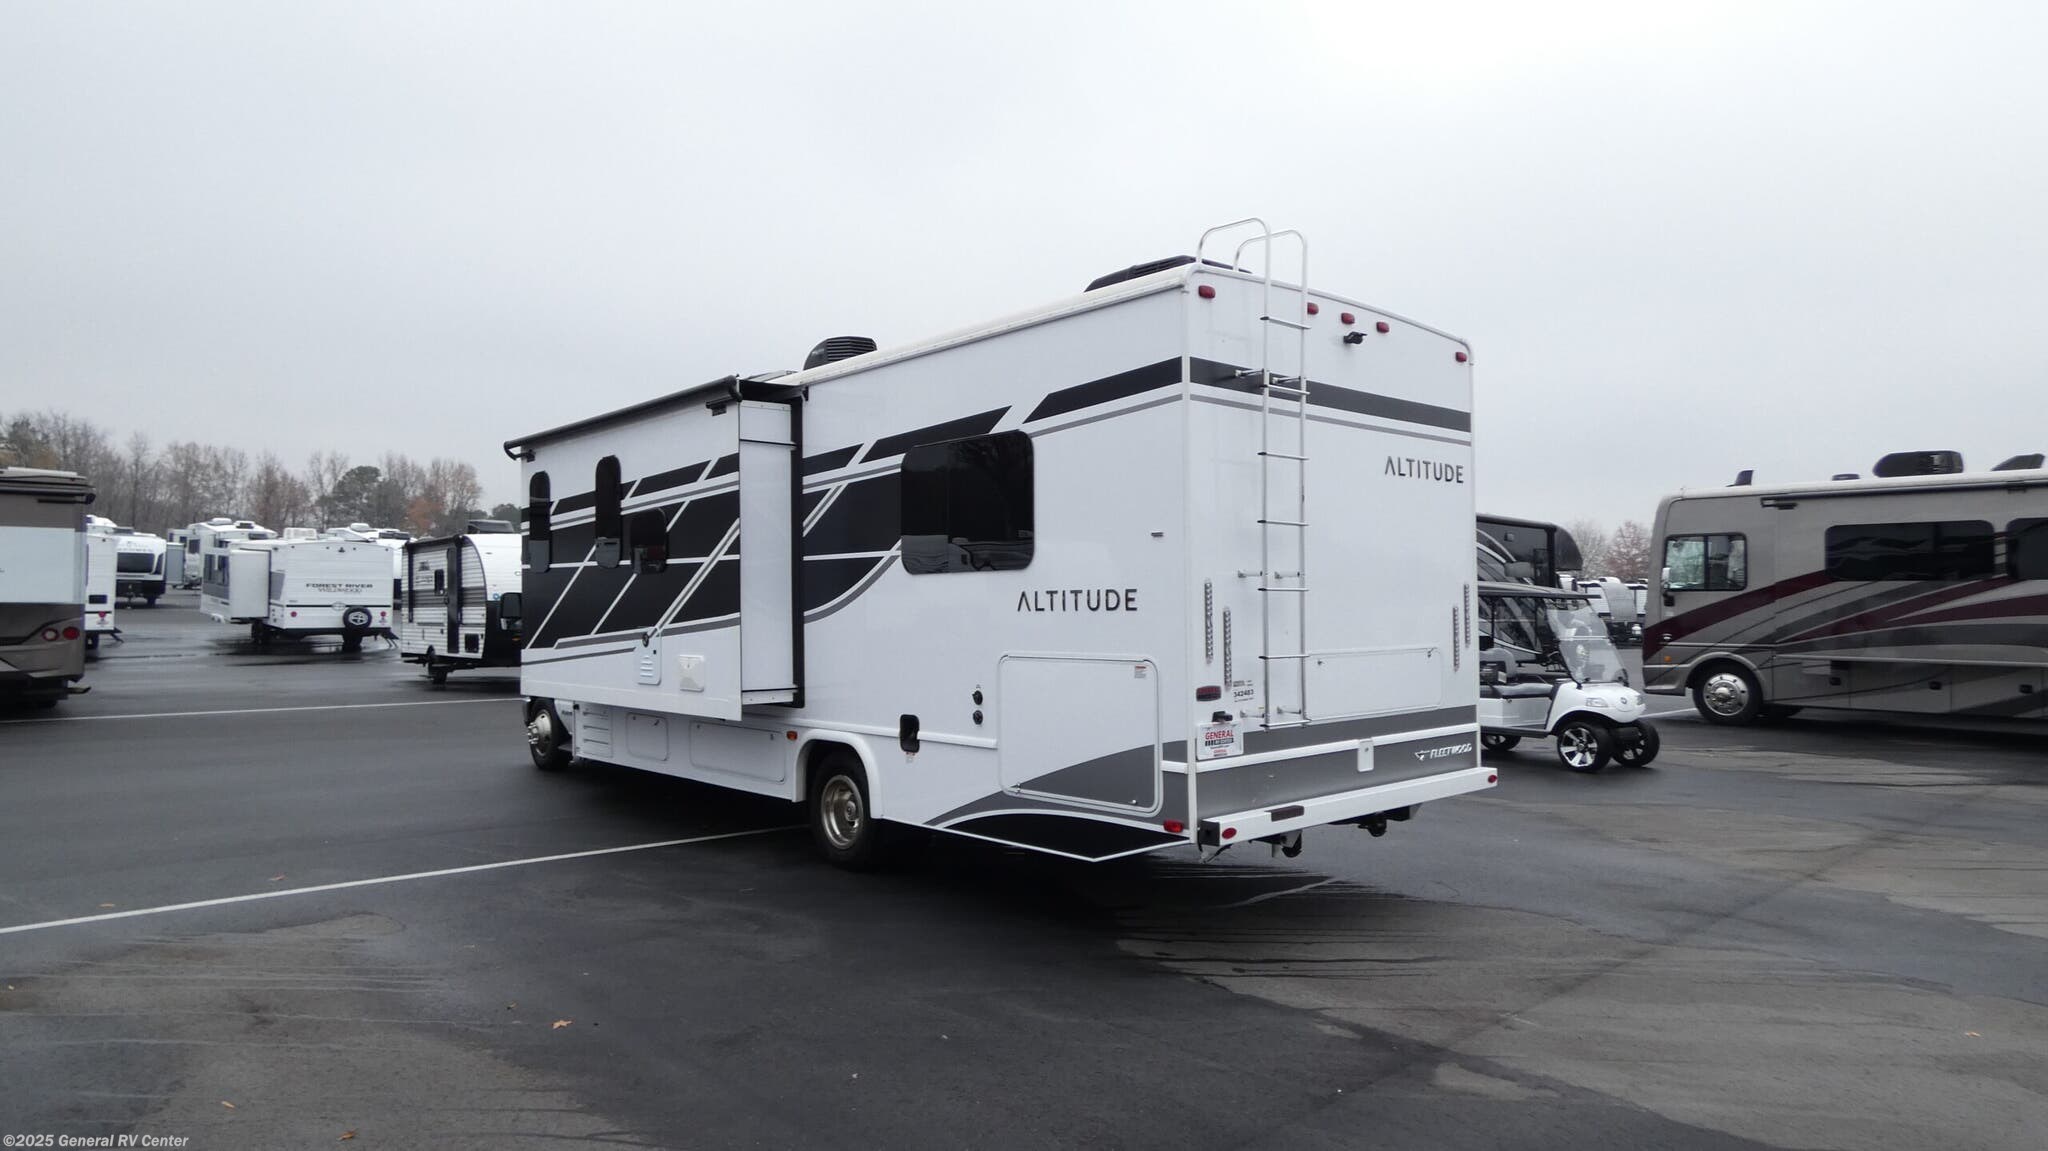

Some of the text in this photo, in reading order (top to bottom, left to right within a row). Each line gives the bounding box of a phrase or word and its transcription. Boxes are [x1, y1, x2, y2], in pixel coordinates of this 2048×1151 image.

[1385, 455, 1464, 484] ALTITUDE
[1017, 588, 1138, 612] ALTITUDE
[1205, 730, 1234, 740] GENERAL
